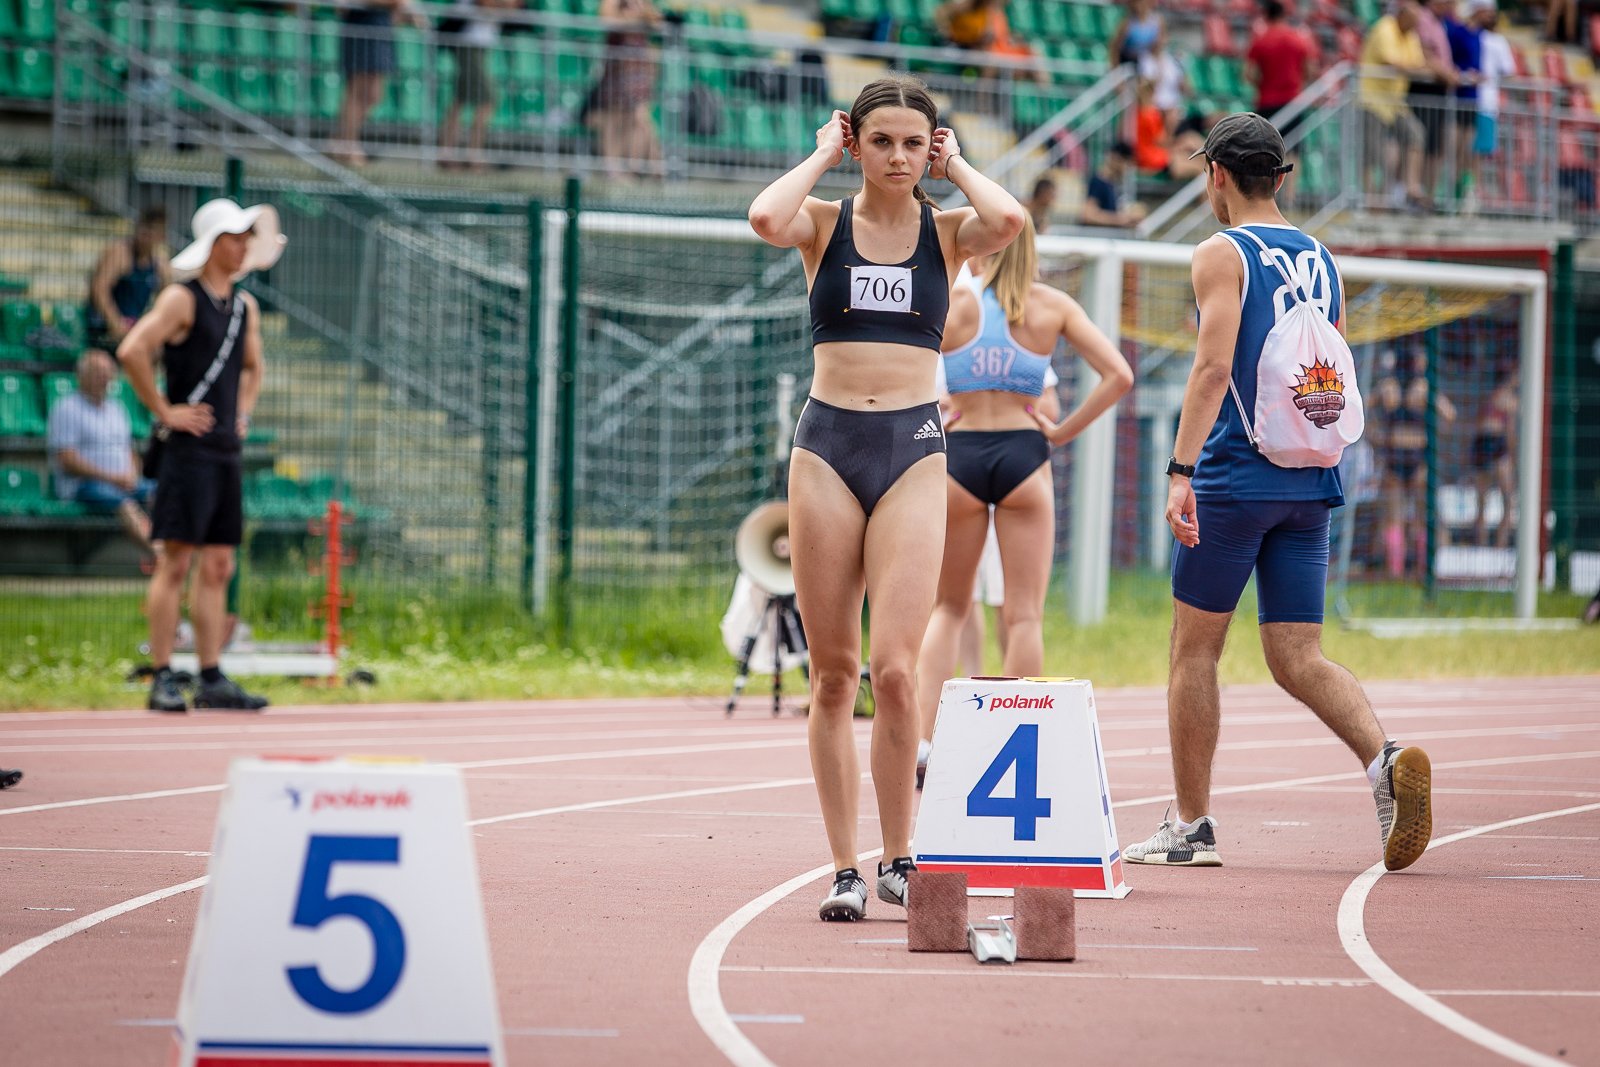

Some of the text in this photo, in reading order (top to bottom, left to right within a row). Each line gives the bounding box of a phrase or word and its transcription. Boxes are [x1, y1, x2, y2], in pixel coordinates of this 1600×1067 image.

[855, 277, 906, 303] 706
[971, 346, 1017, 378] 367
[913, 430, 941, 440] adidas
[989, 694, 1055, 712] polanik
[967, 723, 1052, 841] 4
[310, 784, 412, 813] polanik
[284, 834, 407, 1016] 5
